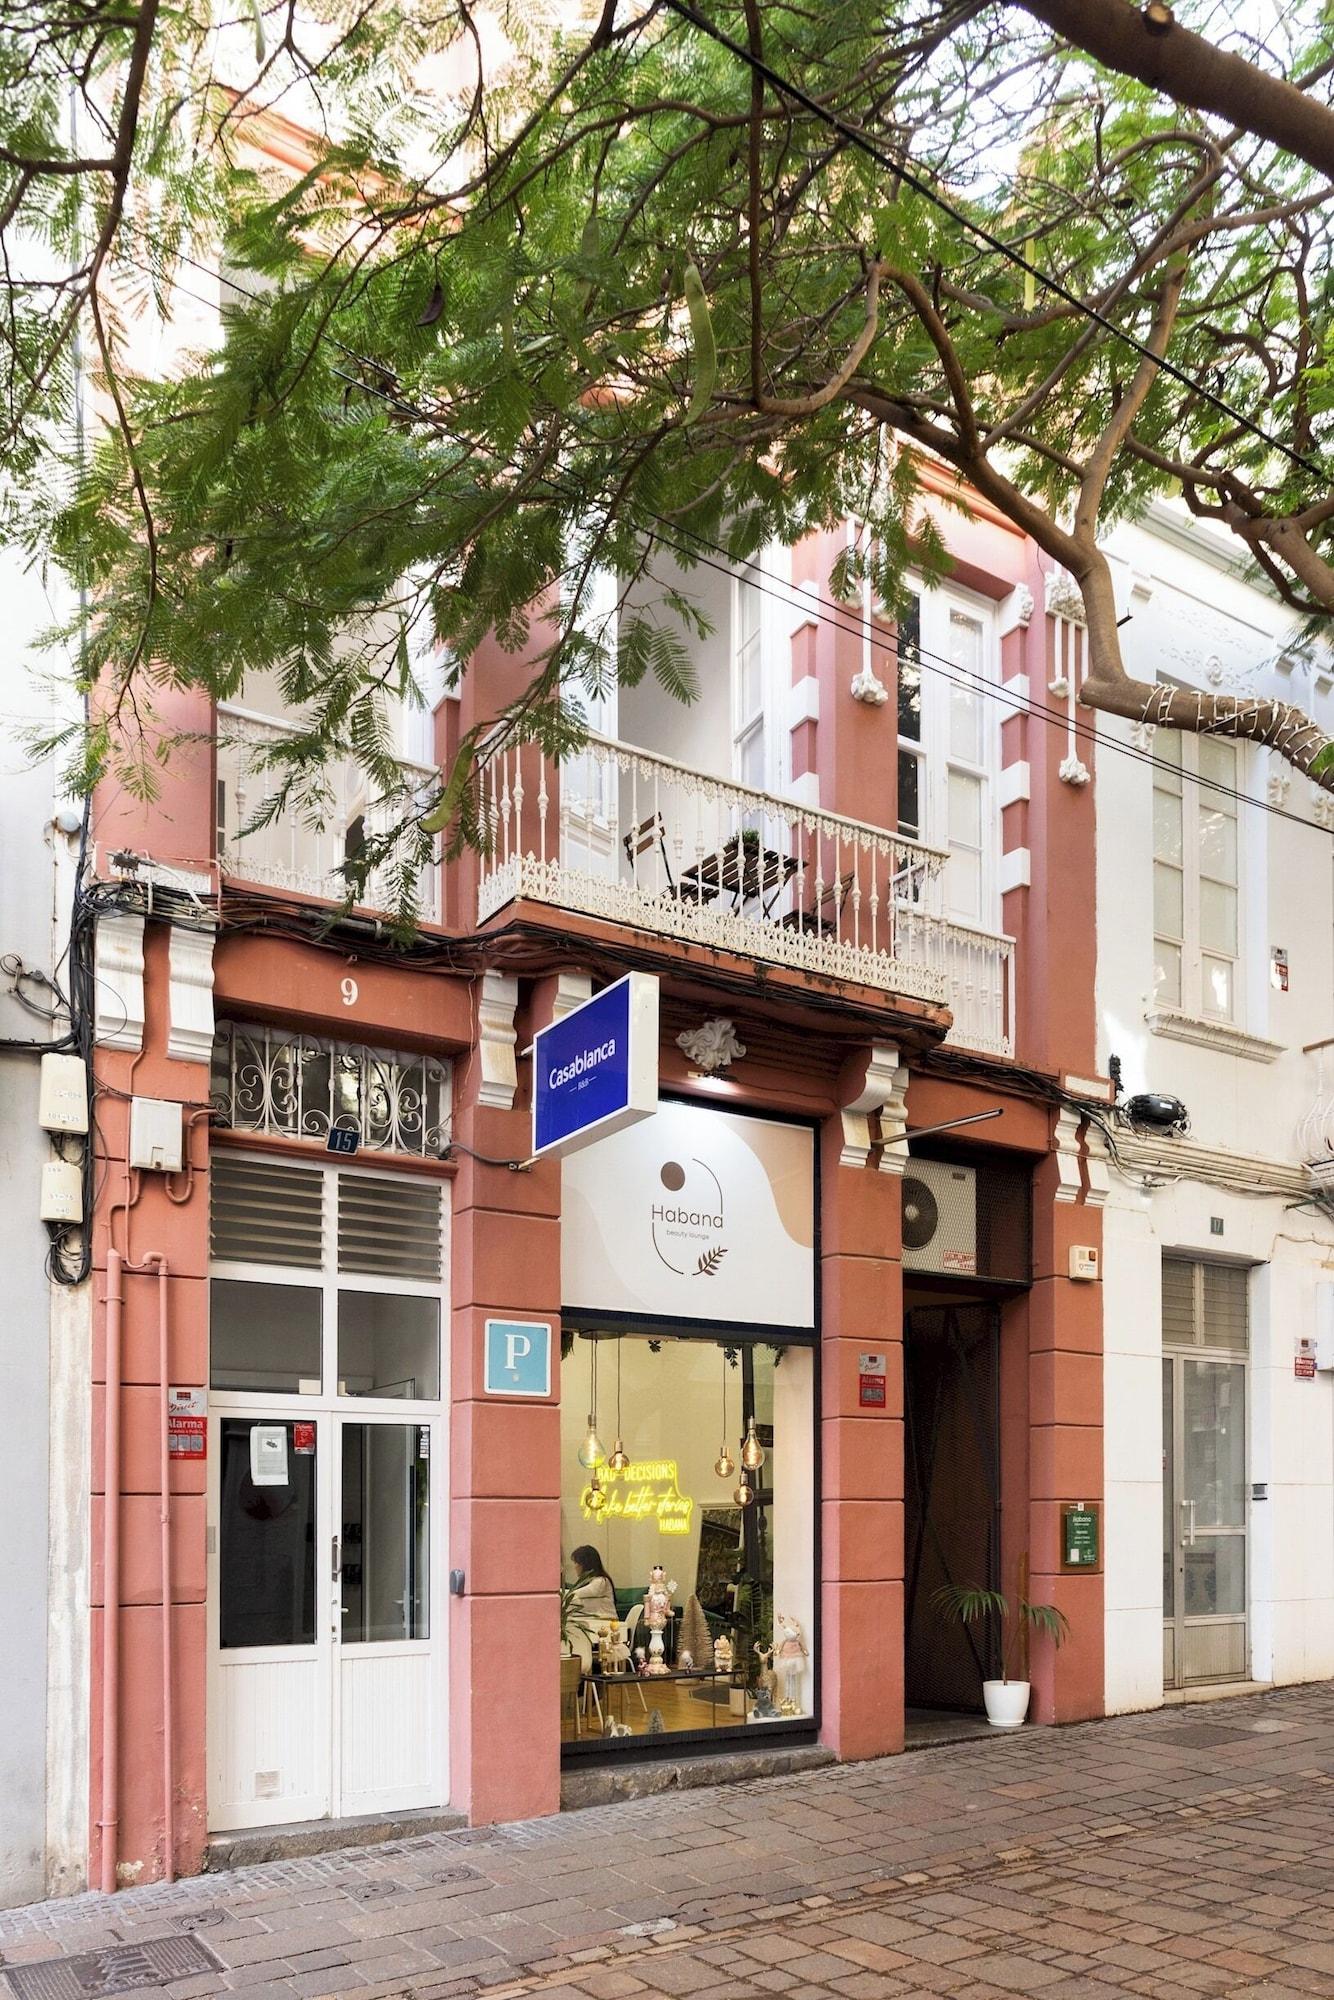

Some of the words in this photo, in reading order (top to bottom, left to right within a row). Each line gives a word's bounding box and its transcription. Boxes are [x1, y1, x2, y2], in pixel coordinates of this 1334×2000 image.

[340, 977, 359, 1006] 9
[549, 1039, 616, 1090] Casablanca
[335, 1132, 352, 1150] 15
[652, 1204, 723, 1229] Habana
[504, 1334, 531, 1370] P
[624, 1463, 675, 1481] DECISIONS
